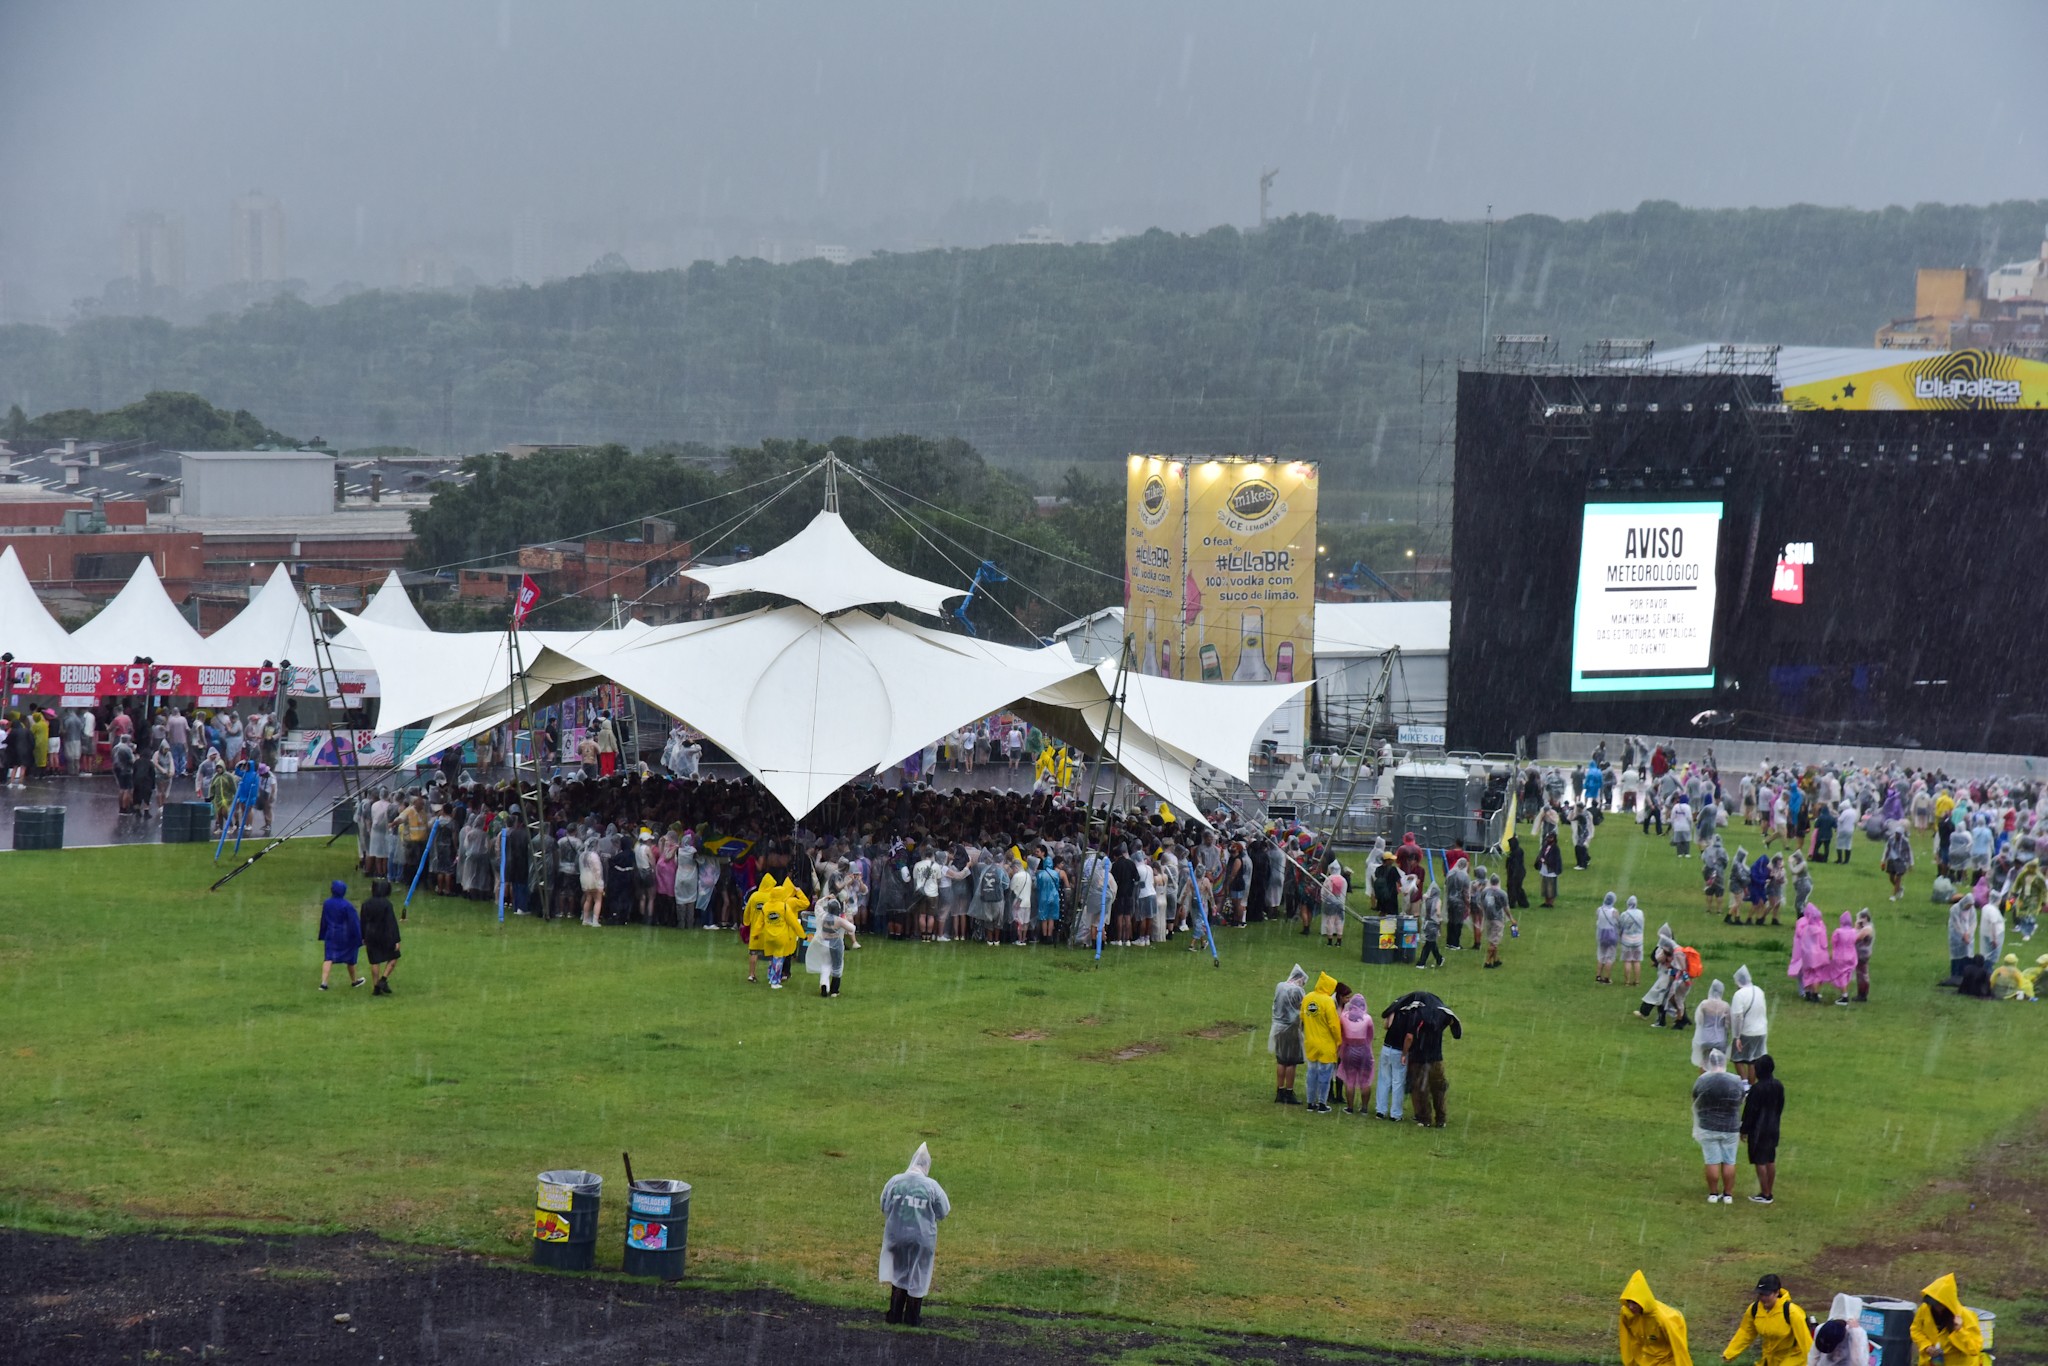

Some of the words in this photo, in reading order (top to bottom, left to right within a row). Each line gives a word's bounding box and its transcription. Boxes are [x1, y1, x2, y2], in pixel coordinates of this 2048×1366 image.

[1916, 374, 2022, 400] Lollapalooza
[1234, 489, 1274, 508] mike's
[1226, 518, 1244, 531] ICE
[1246, 513, 1280, 532] LEMONADE
[1203, 537, 1211, 546] O
[1213, 536, 1233, 546] feat
[1625, 527, 1683, 559] AVISO
[1607, 560, 1699, 582] METEOROLÓGICO
[1206, 577, 1228, 587] 100%
[1230, 575, 1264, 586] vodka
[1268, 576, 1293, 585] com
[1220, 592, 1248, 601] suco
[1250, 590, 1262, 600] de
[1264, 590, 1300, 600] limão.
[1630, 599, 1643, 610] POR
[1645, 598, 1668, 609] FAVOR
[1652, 614, 1660, 624] SE
[1663, 612, 1684, 624] LONGE
[1596, 630, 1611, 640] DAS
[1613, 628, 1656, 640] ESTRUTURAS
[1629, 644, 1638, 654] DO
[1641, 643, 1666, 654] EVENTO
[60, 666, 102, 684] BEBIDAS
[198, 668, 236, 686] BEBIDAS
[64, 684, 96, 694] BEVERAGES
[202, 686, 230, 696] BEVERAGES
[1400, 734, 1428, 742] MIKE'S
[1430, 734, 1444, 743] ICE
